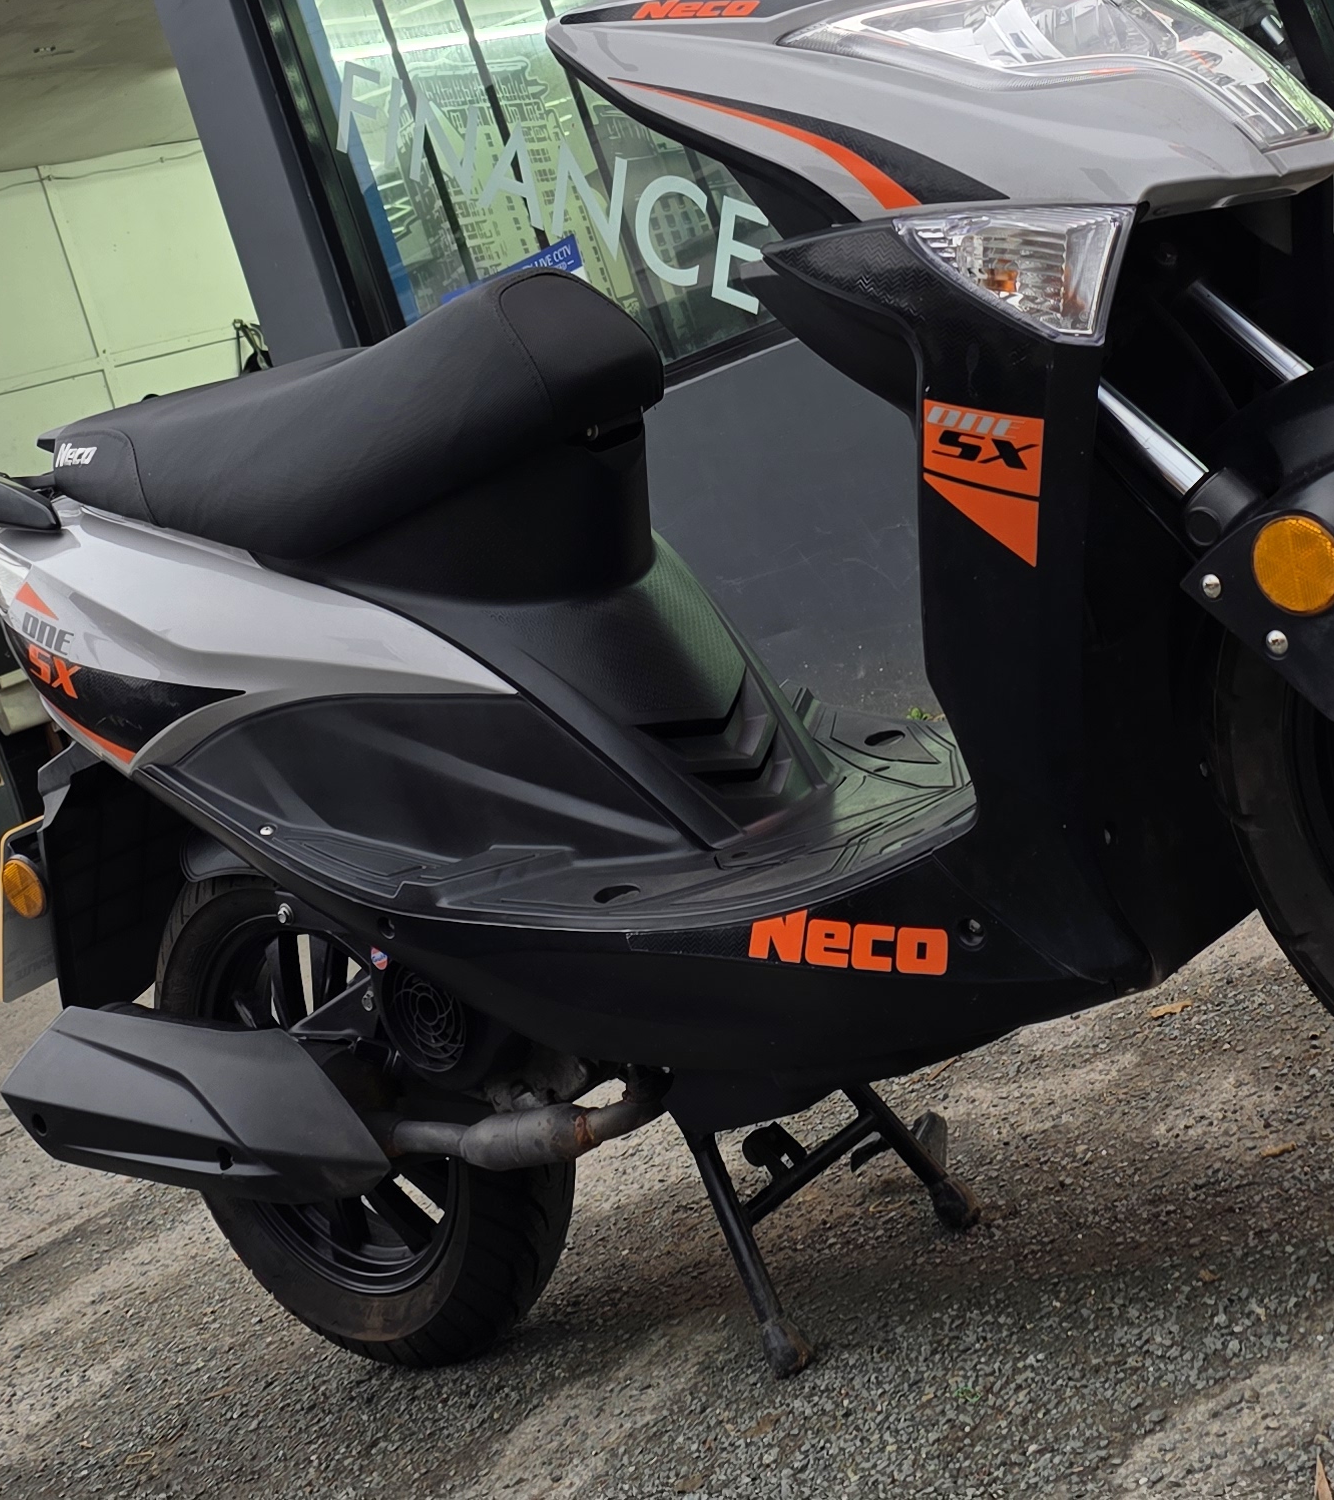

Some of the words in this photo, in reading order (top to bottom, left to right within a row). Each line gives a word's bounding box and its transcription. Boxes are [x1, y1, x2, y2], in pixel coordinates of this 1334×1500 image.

[336, 61, 770, 315] FINANCE
[553, 244, 572, 263] CCTV
[55, 442, 97, 468] Neco
[931, 429, 1040, 471] SX
[28, 643, 82, 700] SX
[748, 908, 949, 976] Neco
